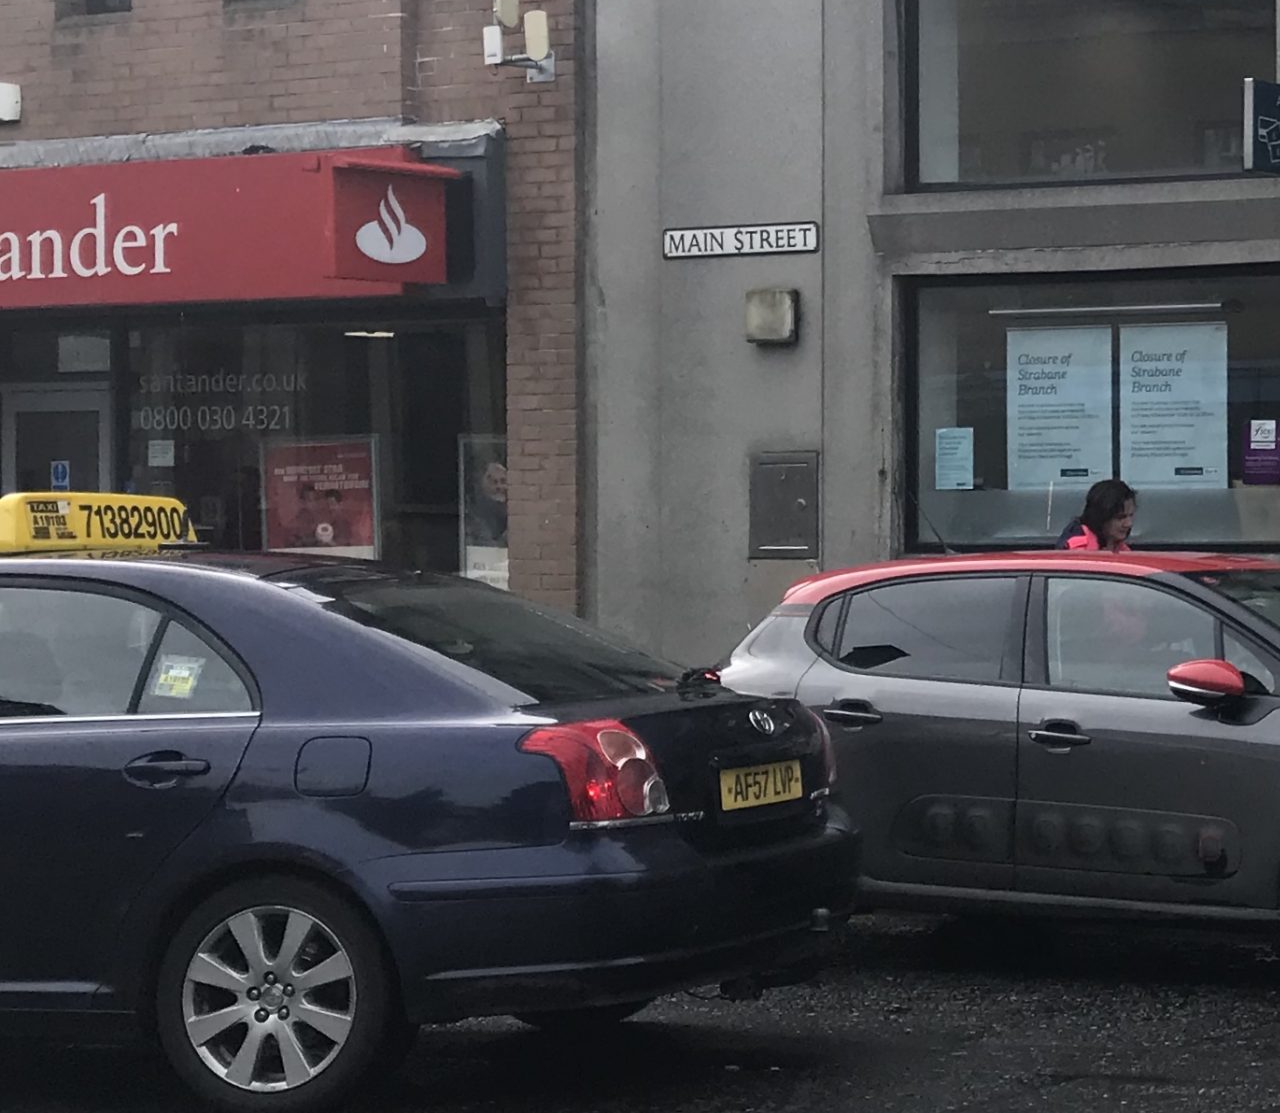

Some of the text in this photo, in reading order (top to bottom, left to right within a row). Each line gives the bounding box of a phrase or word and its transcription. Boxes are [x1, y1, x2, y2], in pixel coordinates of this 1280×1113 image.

[0, 192, 178, 281] ander
[668, 227, 812, 254] MAIN STREET
[1018, 353, 1073, 367] Closure of
[1131, 350, 1188, 364] Closure of
[1018, 368, 1067, 381] Strabane
[1131, 365, 1183, 377] Strabane
[138, 368, 307, 393] santander.co.uk
[1131, 381, 1173, 393] Branch
[1018, 384, 1058, 396] Branch
[140, 405, 290, 430] 0800 030 4321
[33, 503, 57, 512] TAXI
[78, 504, 182, 539] 71382900
[733, 765, 795, 803] AF57 LVP
